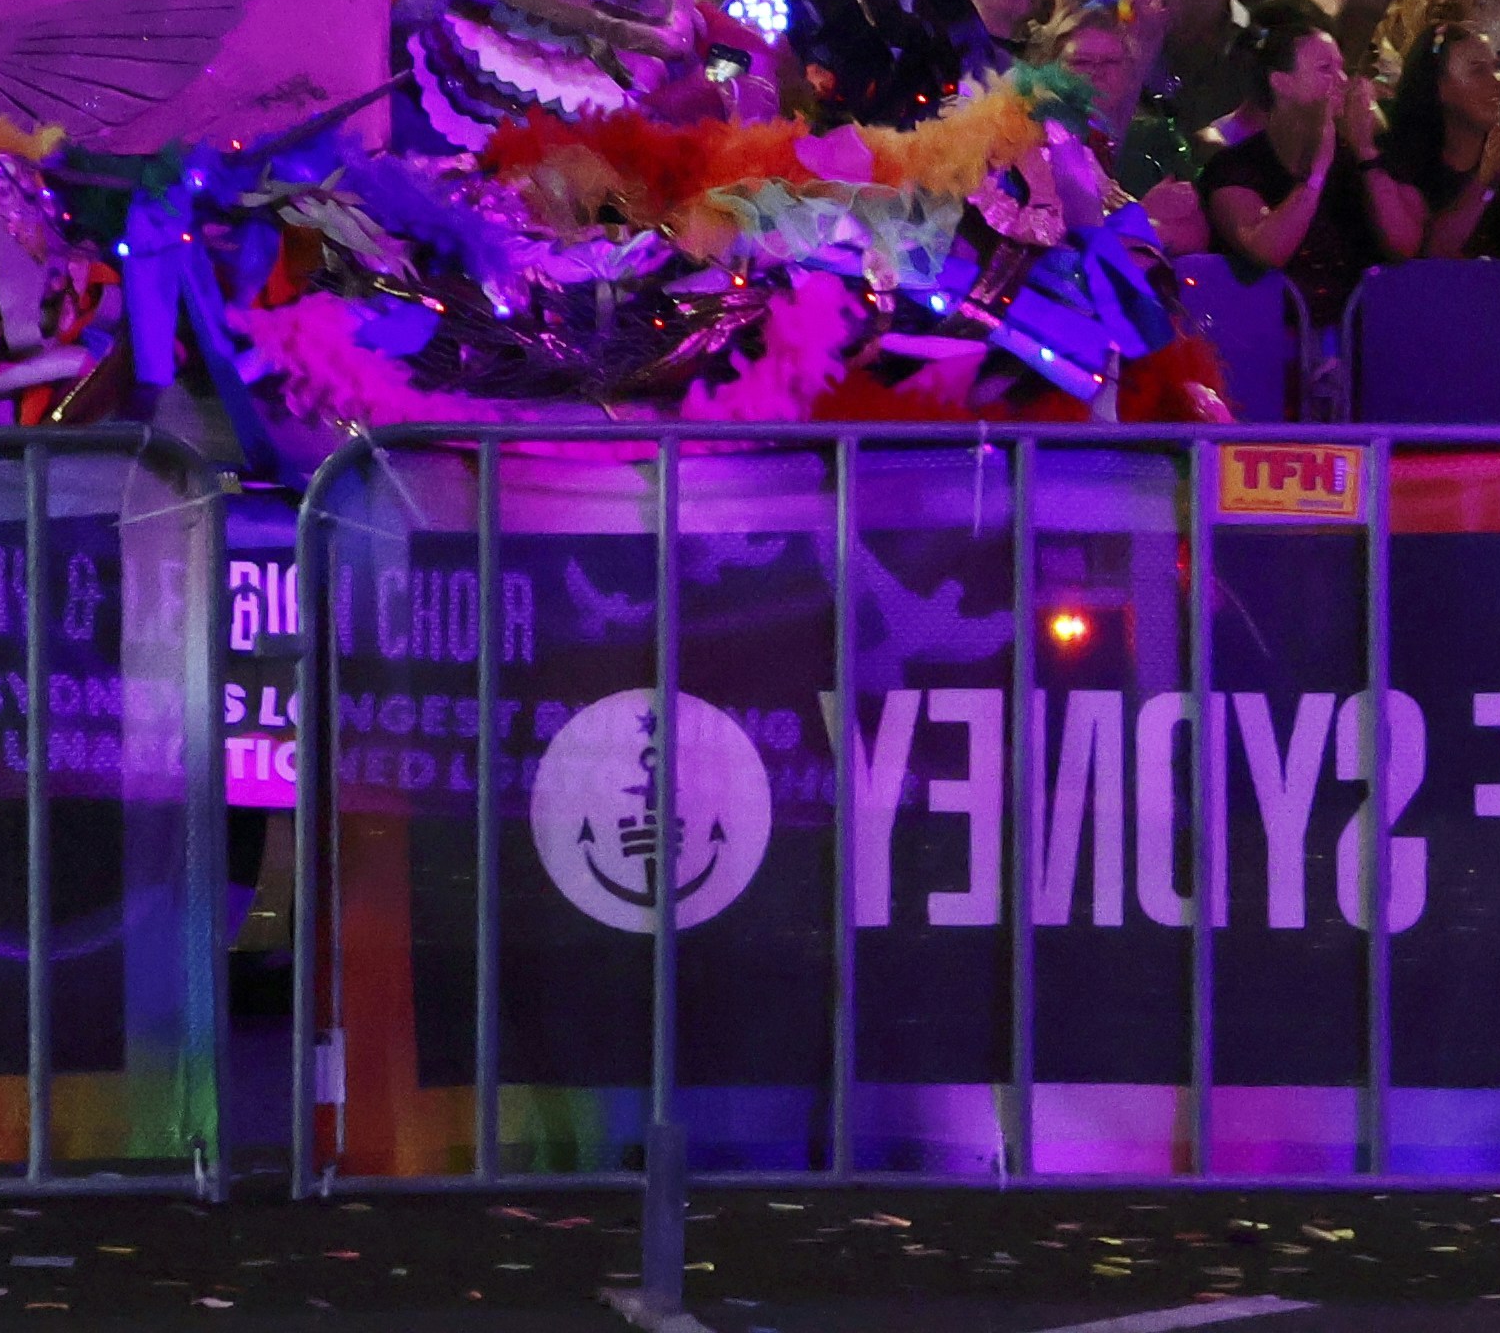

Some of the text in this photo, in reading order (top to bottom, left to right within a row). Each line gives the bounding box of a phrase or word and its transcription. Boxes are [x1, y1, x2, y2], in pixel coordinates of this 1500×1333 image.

[1233, 449, 1335, 494] TFH
[377, 567, 535, 664] CHOR
[258, 685, 522, 740] LNGEST
